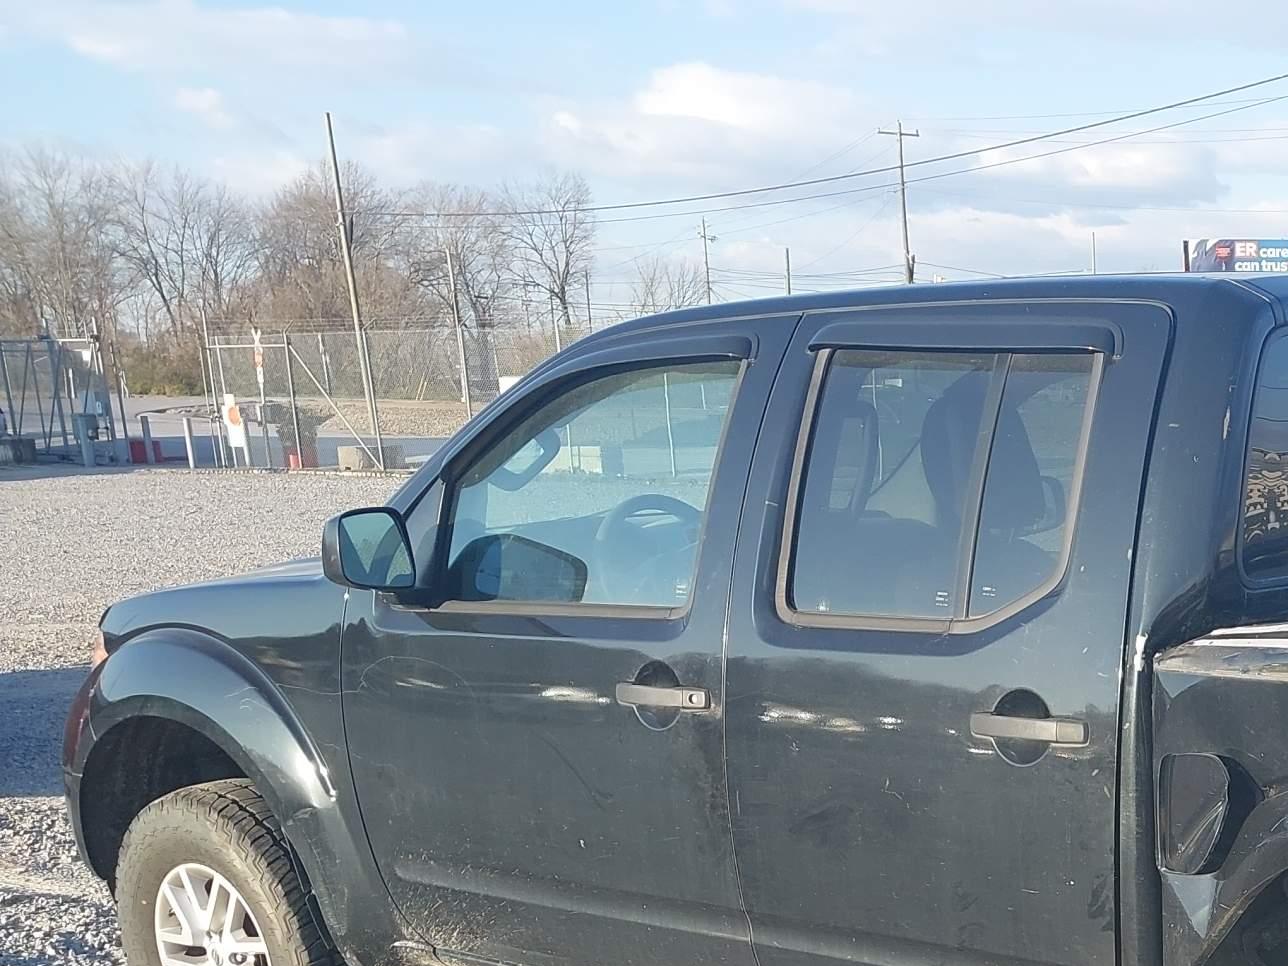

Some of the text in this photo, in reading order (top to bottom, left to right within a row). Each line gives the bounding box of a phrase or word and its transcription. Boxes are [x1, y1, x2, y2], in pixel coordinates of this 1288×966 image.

[1235, 242, 1257, 257] ER
[1259, 247, 1288, 258] care
[1234, 261, 1260, 272] can
